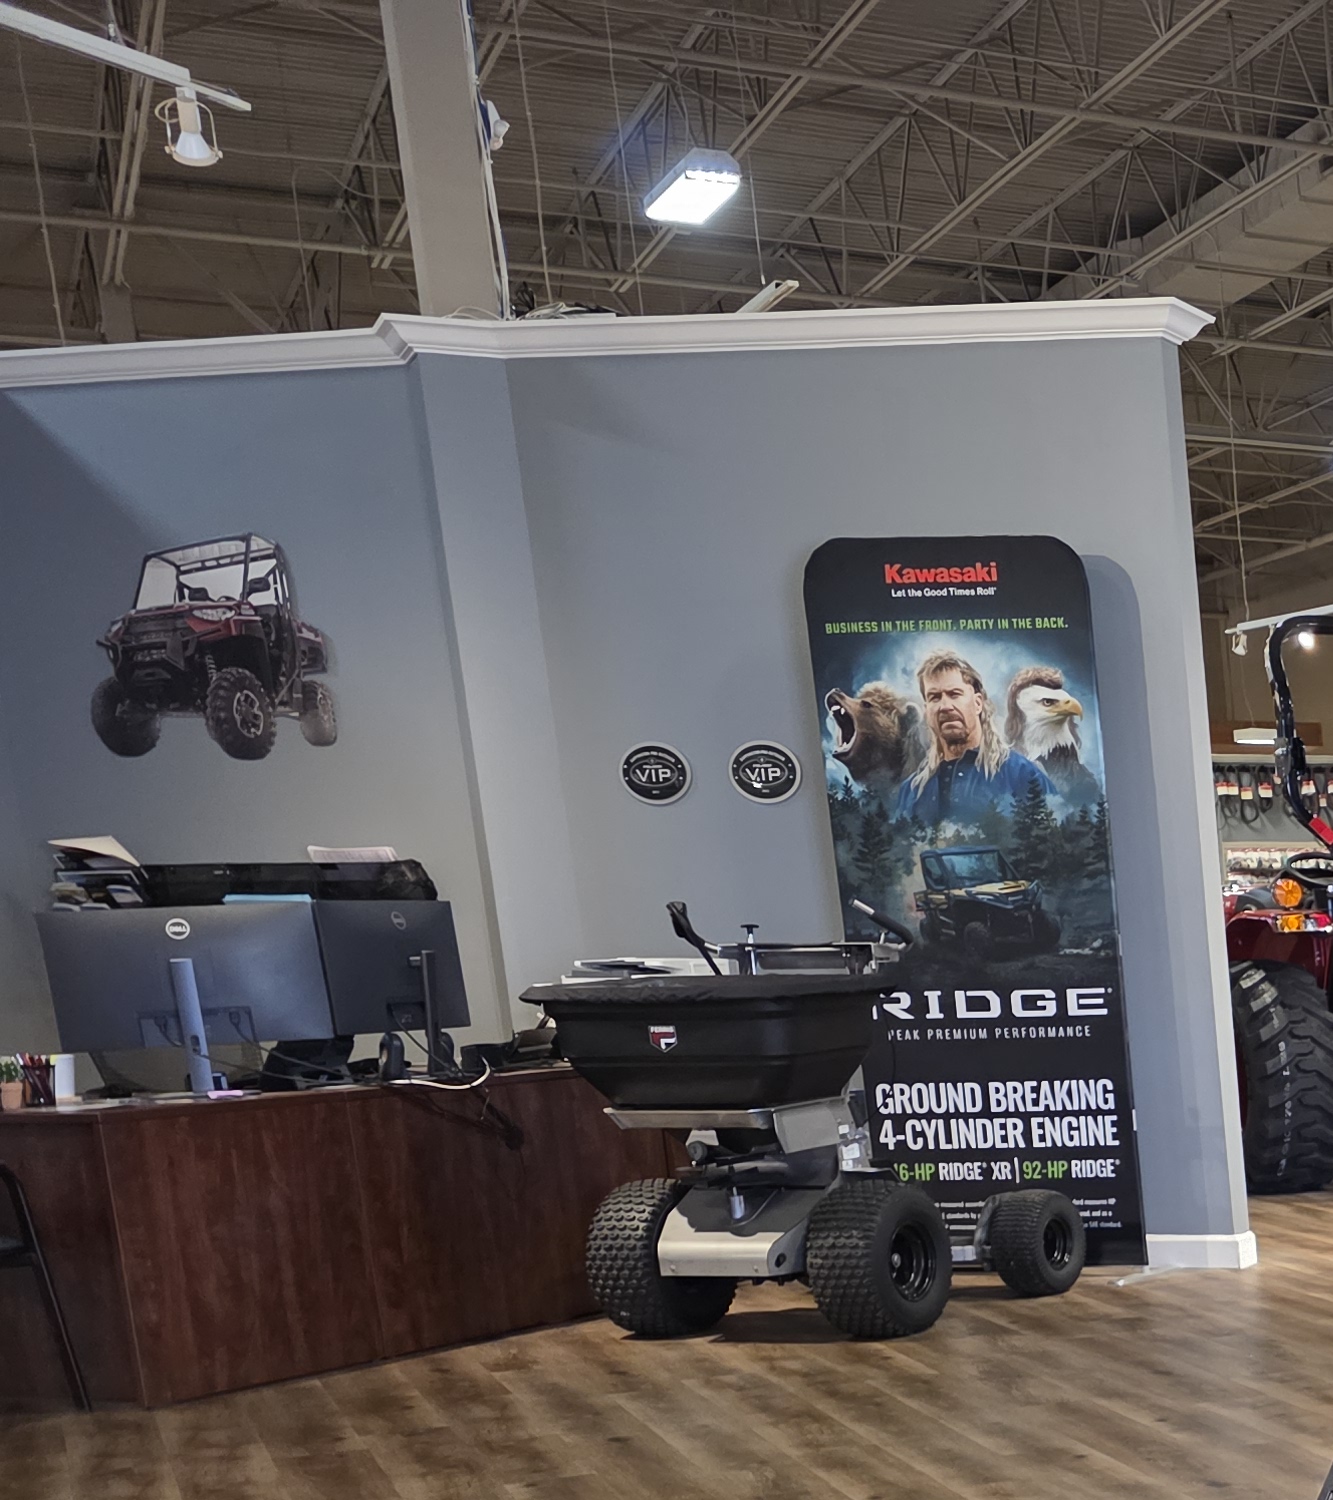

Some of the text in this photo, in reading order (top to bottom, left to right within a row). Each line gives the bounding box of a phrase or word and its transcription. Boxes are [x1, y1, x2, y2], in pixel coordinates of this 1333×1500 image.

[884, 561, 998, 584] Kawasaki
[891, 588, 906, 598] Let
[907, 587, 922, 598] the
[923, 586, 947, 597] Good
[948, 586, 975, 597] Times
[825, 616, 1069, 635] BUSINESS IN THE FRONT. PARTY IN THE BACK.
[634, 768, 673, 784] VIP
[744, 766, 782, 782] VIP
[872, 987, 1109, 1020] RIDGE
[927, 1028, 988, 1041] PREMIUM
[994, 1025, 1092, 1039] PERFORMANCE
[875, 1078, 1116, 1115] GROUND BREAKING
[879, 1115, 1120, 1151] 4-CYLINDER ENGINE
[938, 1161, 984, 1181] RIDGE
[990, 1161, 1012, 1180] XR
[1022, 1159, 1068, 1180] 92-HP
[1071, 1158, 1117, 1179] RIDGE
